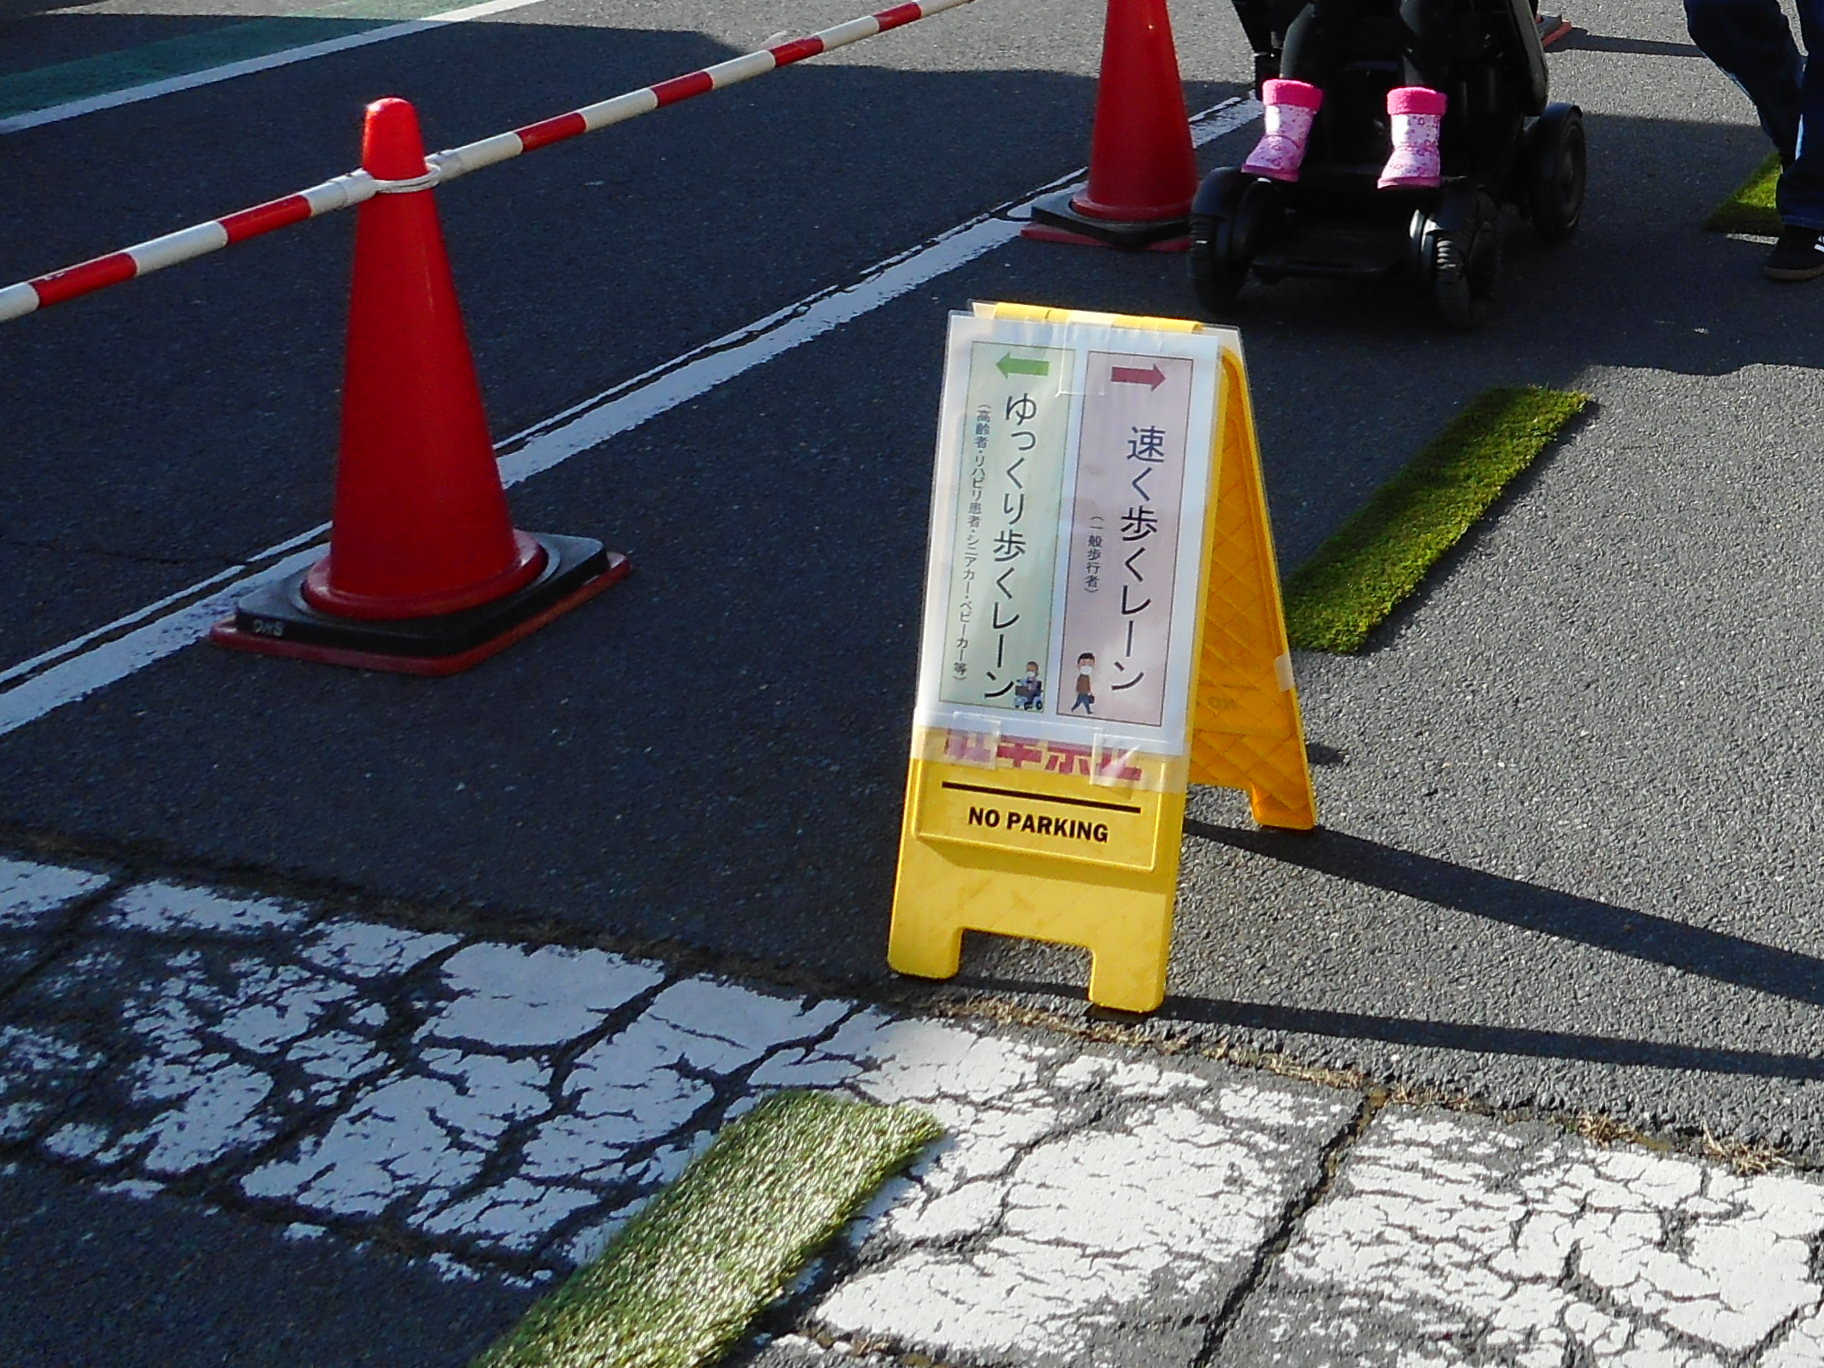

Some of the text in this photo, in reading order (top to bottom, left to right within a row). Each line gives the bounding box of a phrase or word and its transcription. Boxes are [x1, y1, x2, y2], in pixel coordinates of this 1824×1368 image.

[983, 392, 1038, 699] ゆっくり歩くレーン
[1110, 425, 1167, 692] 速く歩くレーン
[967, 805, 1109, 844] NO PARKING
